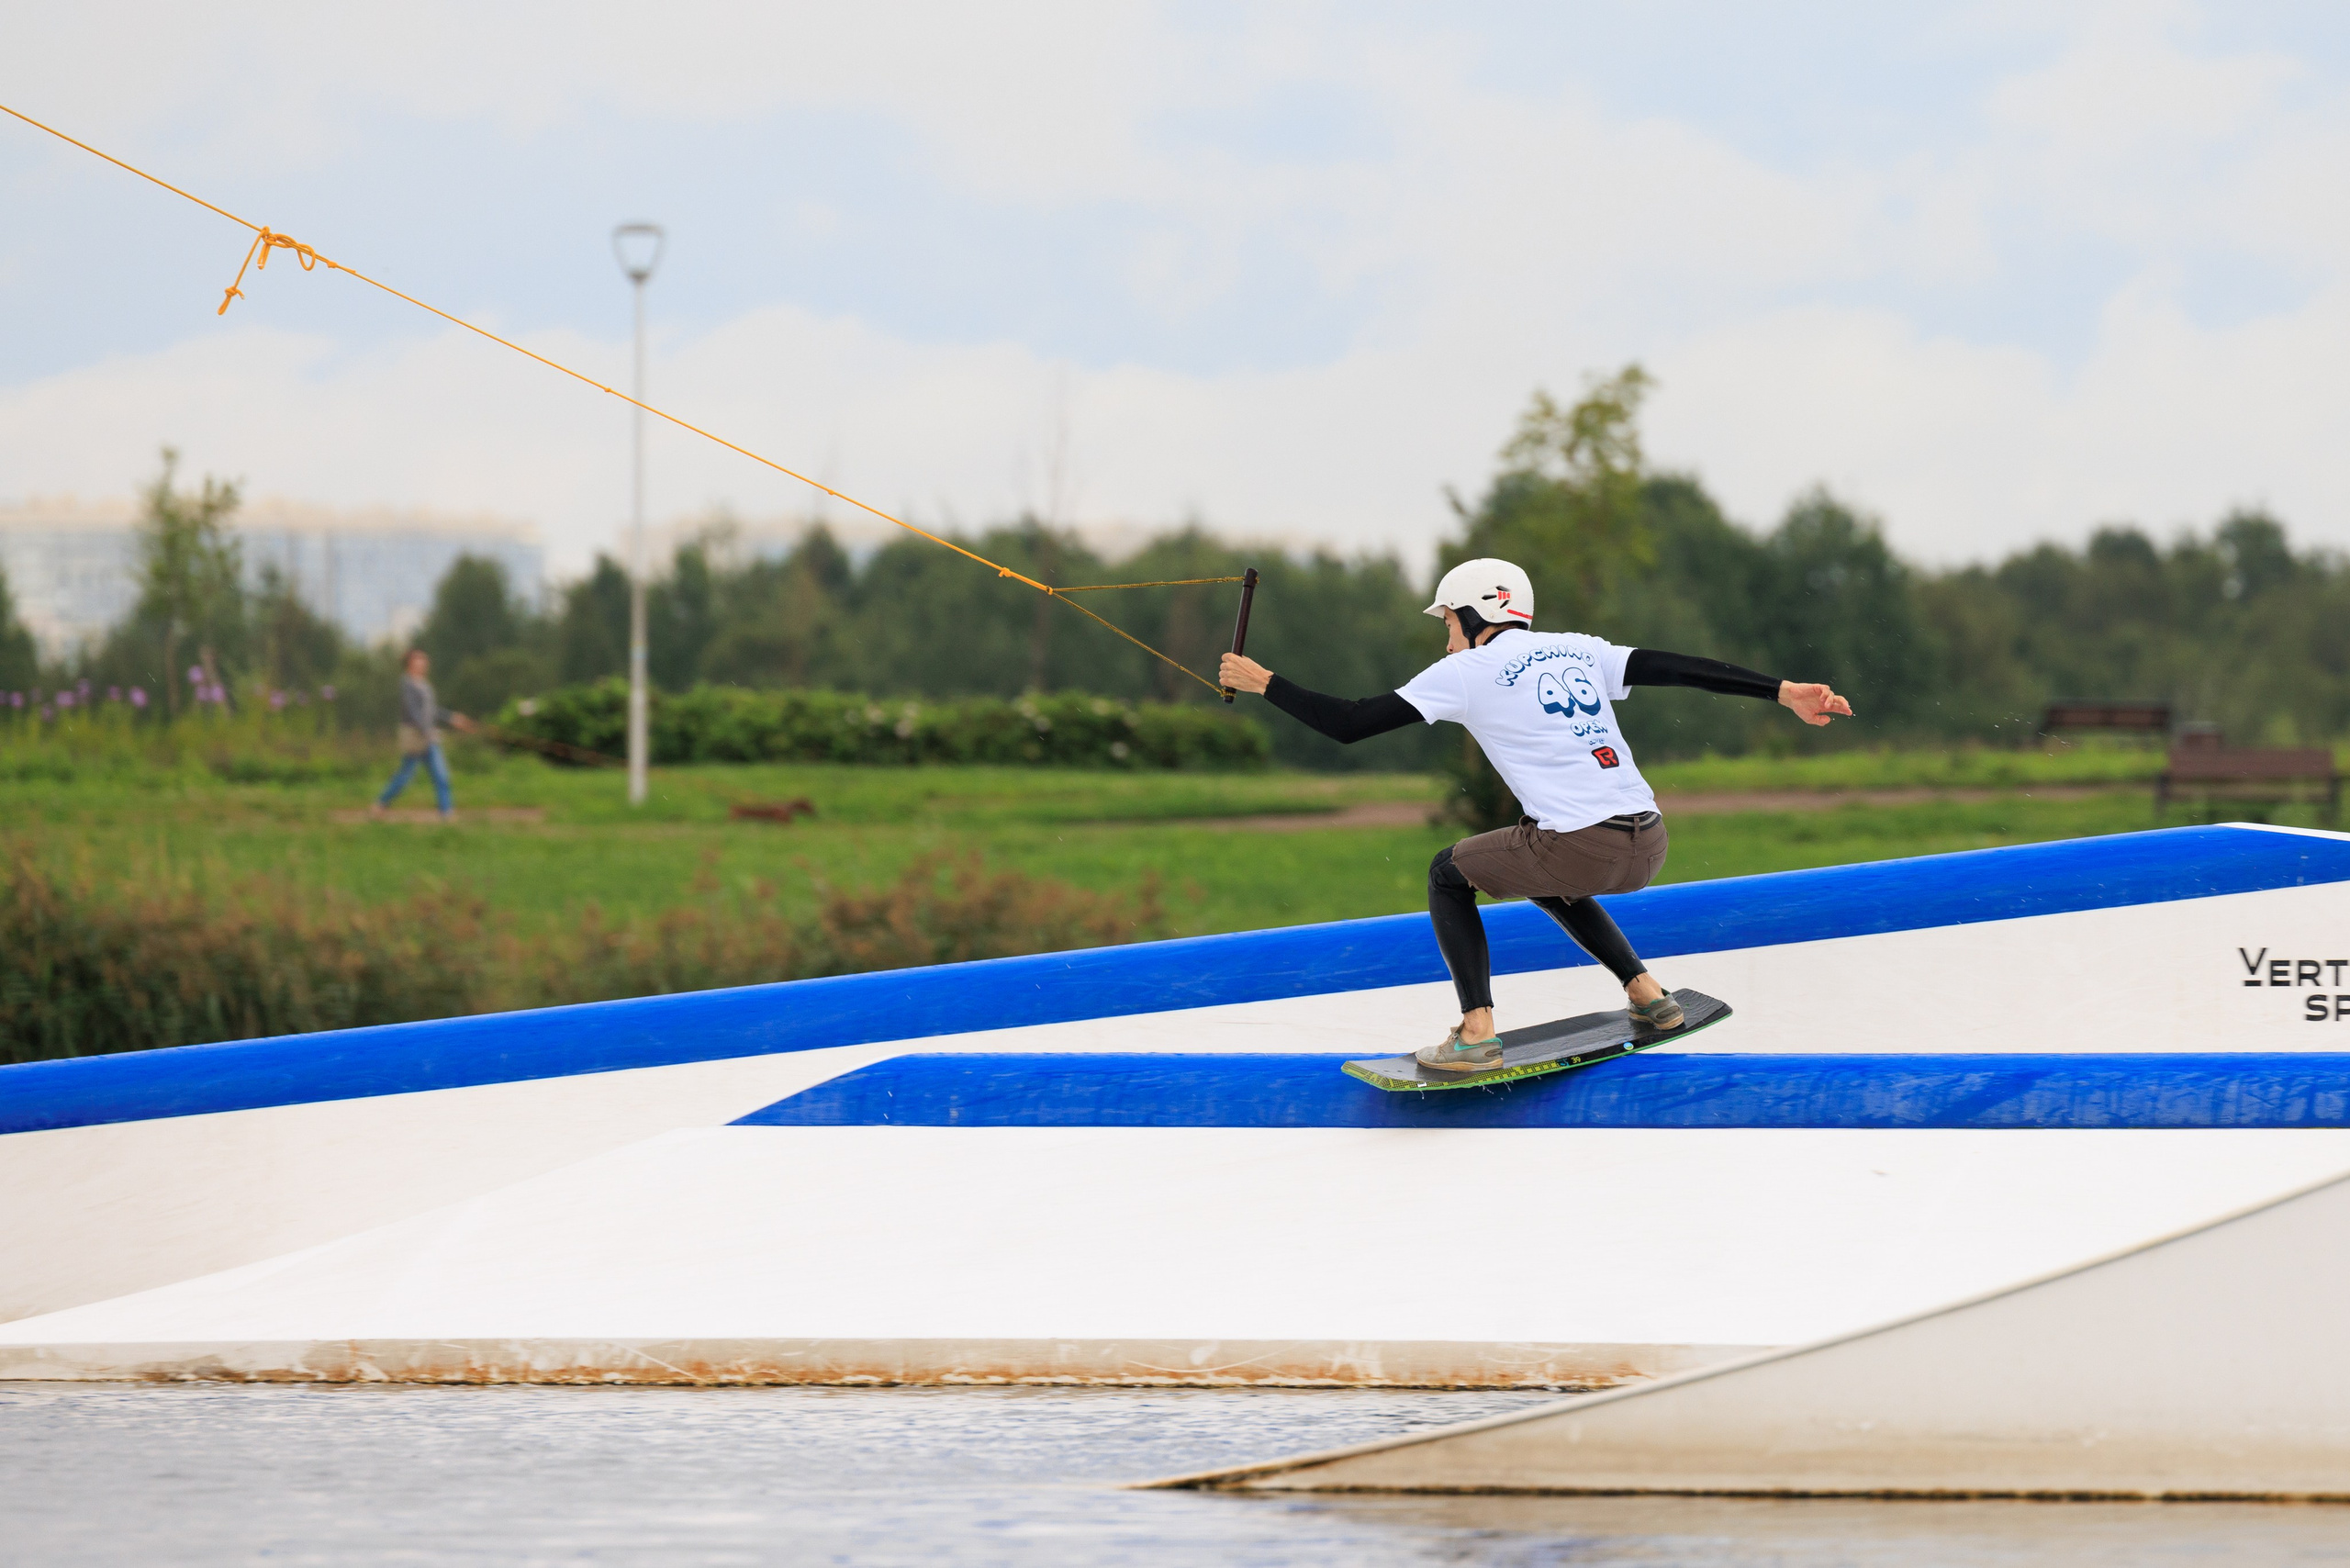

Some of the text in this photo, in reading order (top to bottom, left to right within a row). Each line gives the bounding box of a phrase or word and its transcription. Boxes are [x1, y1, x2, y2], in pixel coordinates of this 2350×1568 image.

[1495, 644, 1595, 686] KUPCHINO
[1538, 667, 1601, 718] 46
[1570, 719, 1608, 737] OPEN
